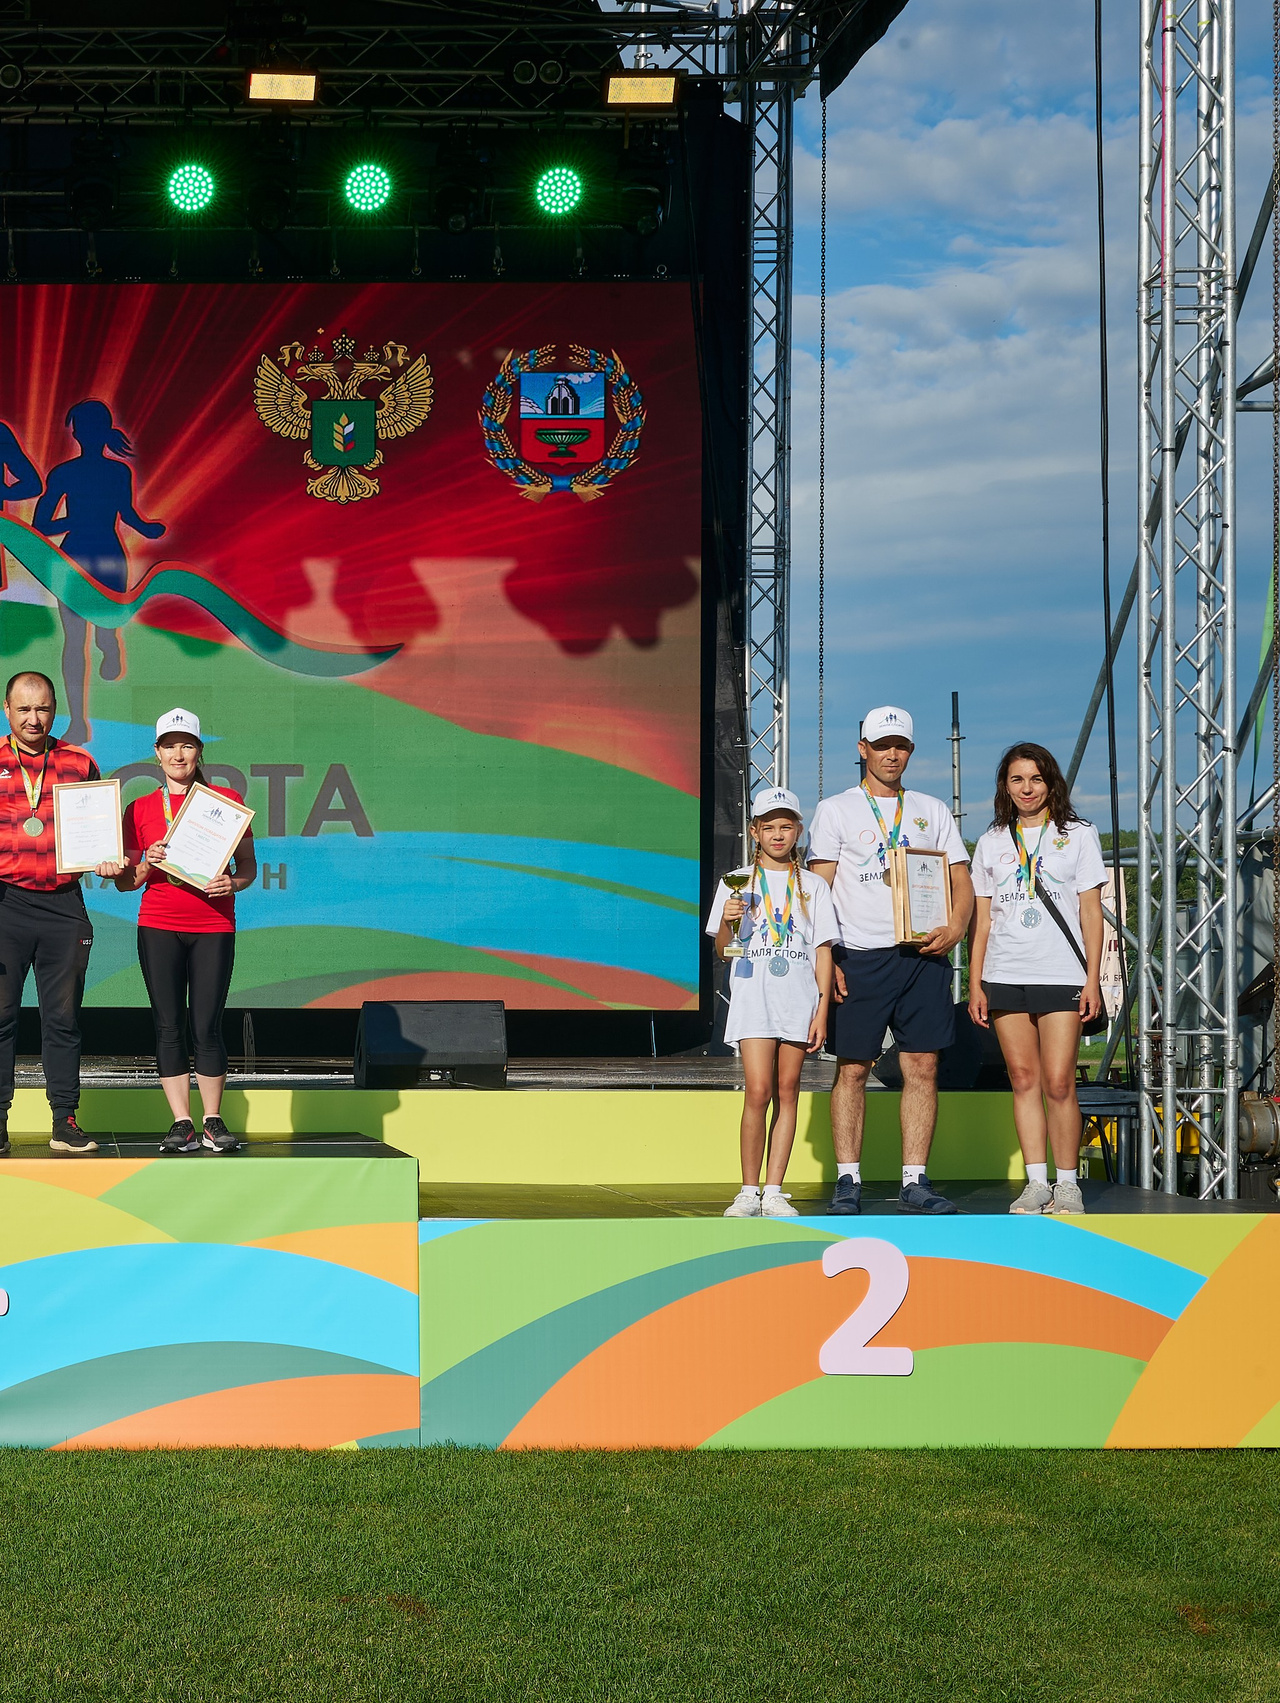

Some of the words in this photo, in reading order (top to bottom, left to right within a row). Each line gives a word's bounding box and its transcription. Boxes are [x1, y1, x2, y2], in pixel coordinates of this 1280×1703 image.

[859, 871, 884, 882] ЗЕМЛ
[744, 948, 772, 959] ЕМЛЯ
[819, 1237, 914, 1377] 2
